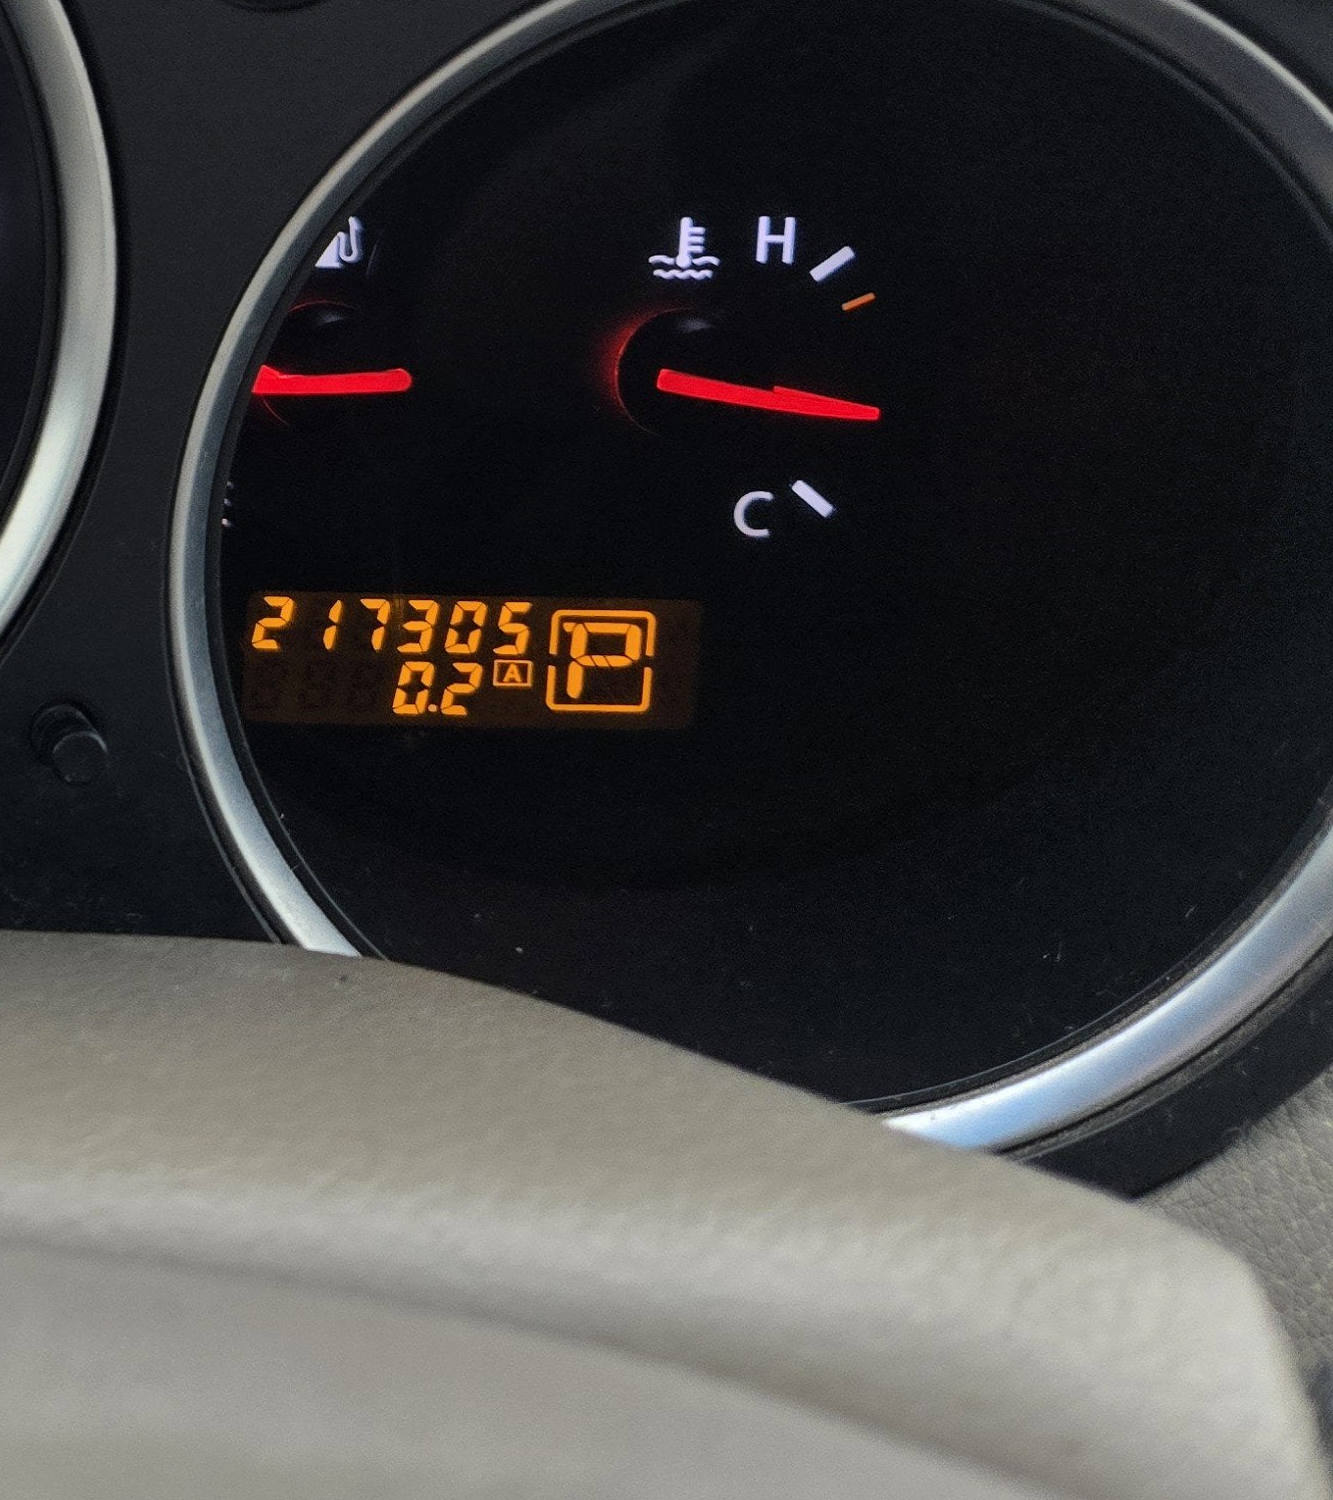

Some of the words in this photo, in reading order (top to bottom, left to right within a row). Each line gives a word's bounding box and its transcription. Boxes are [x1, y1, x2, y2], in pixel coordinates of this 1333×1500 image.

[756, 216, 795, 264] H
[734, 491, 773, 537] C
[251, 595, 532, 656] 217305
[392, 660, 482, 716] 0.2
[562, 622, 642, 700] P
